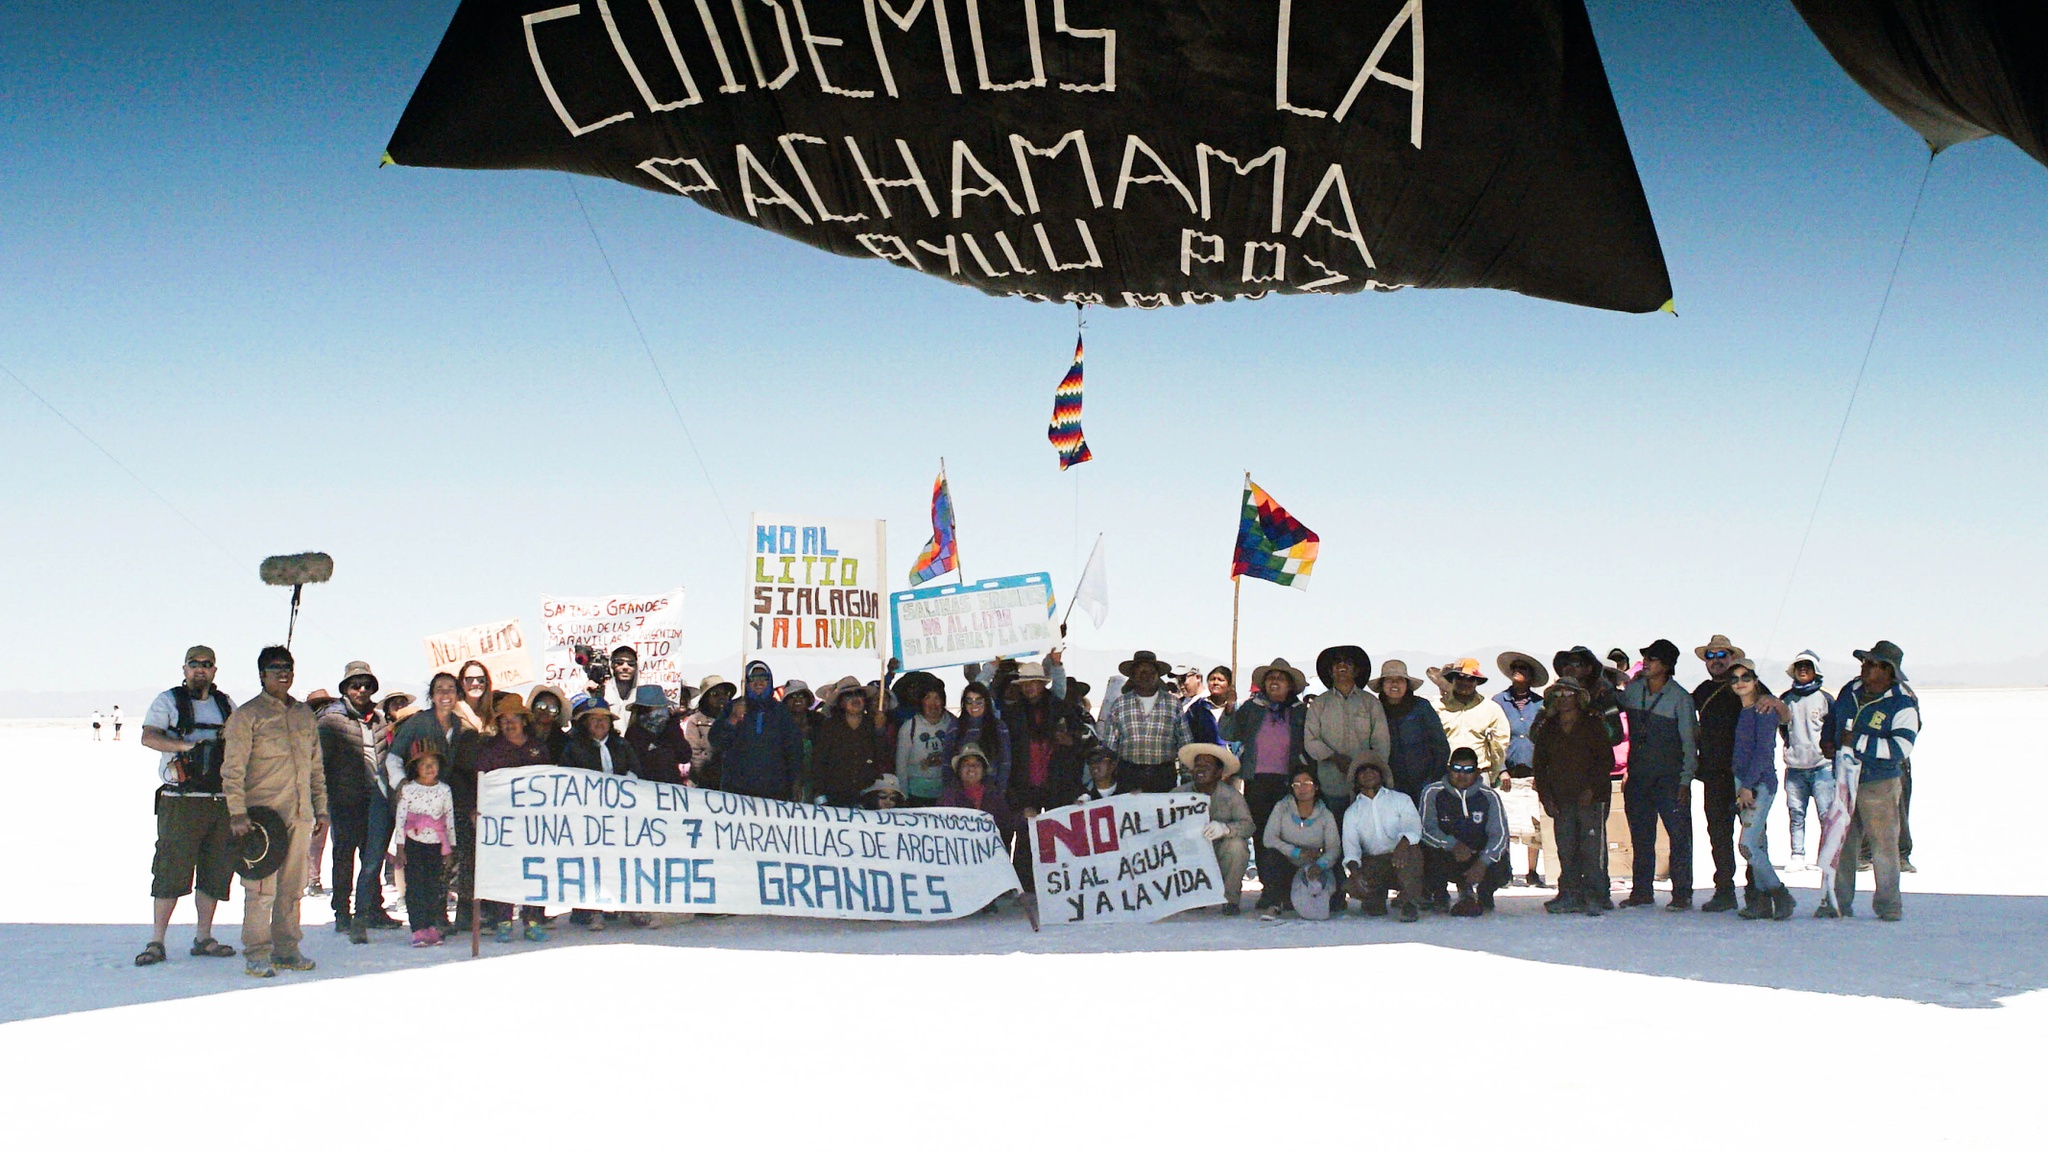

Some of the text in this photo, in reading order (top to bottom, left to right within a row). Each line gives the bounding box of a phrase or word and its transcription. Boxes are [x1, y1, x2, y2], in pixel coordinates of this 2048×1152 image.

[1276, 0, 1422, 149] LA
[636, 129, 1375, 270] PACHAMAMA
[756, 525, 839, 557] NO AL
[755, 556, 858, 586] LITIO
[607, 599, 668, 616] GRANDES
[571, 623, 593, 634] UNA
[750, 617, 763, 649] Y
[772, 618, 789, 648] A
[831, 619, 876, 649] VIDA
[947, 615, 968, 634] AL
[633, 641, 670, 657] ITIO
[904, 637, 921, 656] SI
[926, 635, 944, 653] AL
[1868, 710, 1887, 731] E
[511, 774, 637, 809] ESTAMOS
[655, 783, 689, 812] EN
[481, 815, 1006, 865] DE UNA DE LAS 7 MARAVILLAS DE ARGENTINA
[1036, 805, 1119, 863] NO
[1120, 812, 1149, 839] AL
[1079, 866, 1108, 890] AL
[1117, 840, 1177, 882] AGUA
[522, 856, 953, 915] SALINAS GRANDES
[1066, 893, 1084, 922] Y
[1096, 890, 1114, 915] A
[1121, 883, 1153, 911] LA
